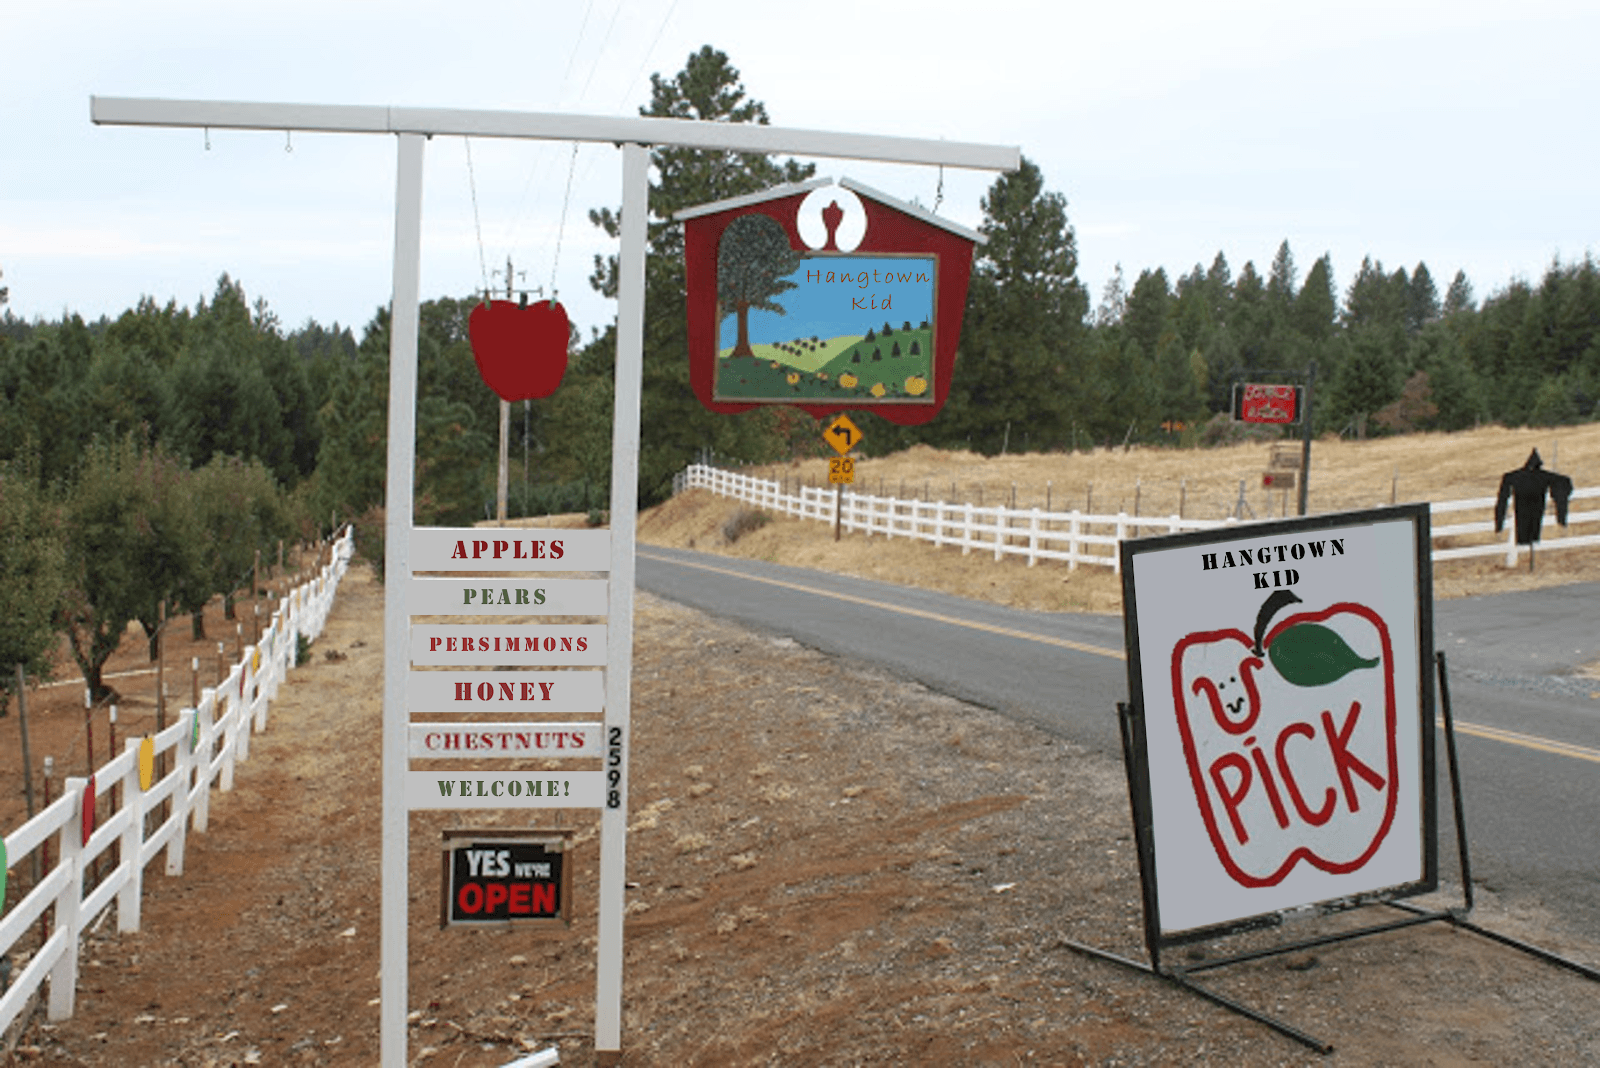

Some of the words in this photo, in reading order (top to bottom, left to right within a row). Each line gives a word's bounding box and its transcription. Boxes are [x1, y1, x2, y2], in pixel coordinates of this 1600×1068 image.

[806, 269, 930, 289] Hangtown
[852, 294, 892, 310] Kid
[831, 459, 853, 473] 20
[451, 540, 565, 559] APPLES
[1201, 538, 1345, 570] HANGTOWN
[1252, 569, 1300, 589] KID
[463, 588, 547, 605] PEARS
[429, 637, 588, 652] PERSIMMONS
[454, 682, 555, 701] HONEY
[425, 732, 586, 751] CHESTNUTS
[607, 727, 621, 809] 2598
[437, 780, 570, 797] WELCOME!
[466, 850, 510, 877] YES
[458, 882, 556, 914] OPEN
